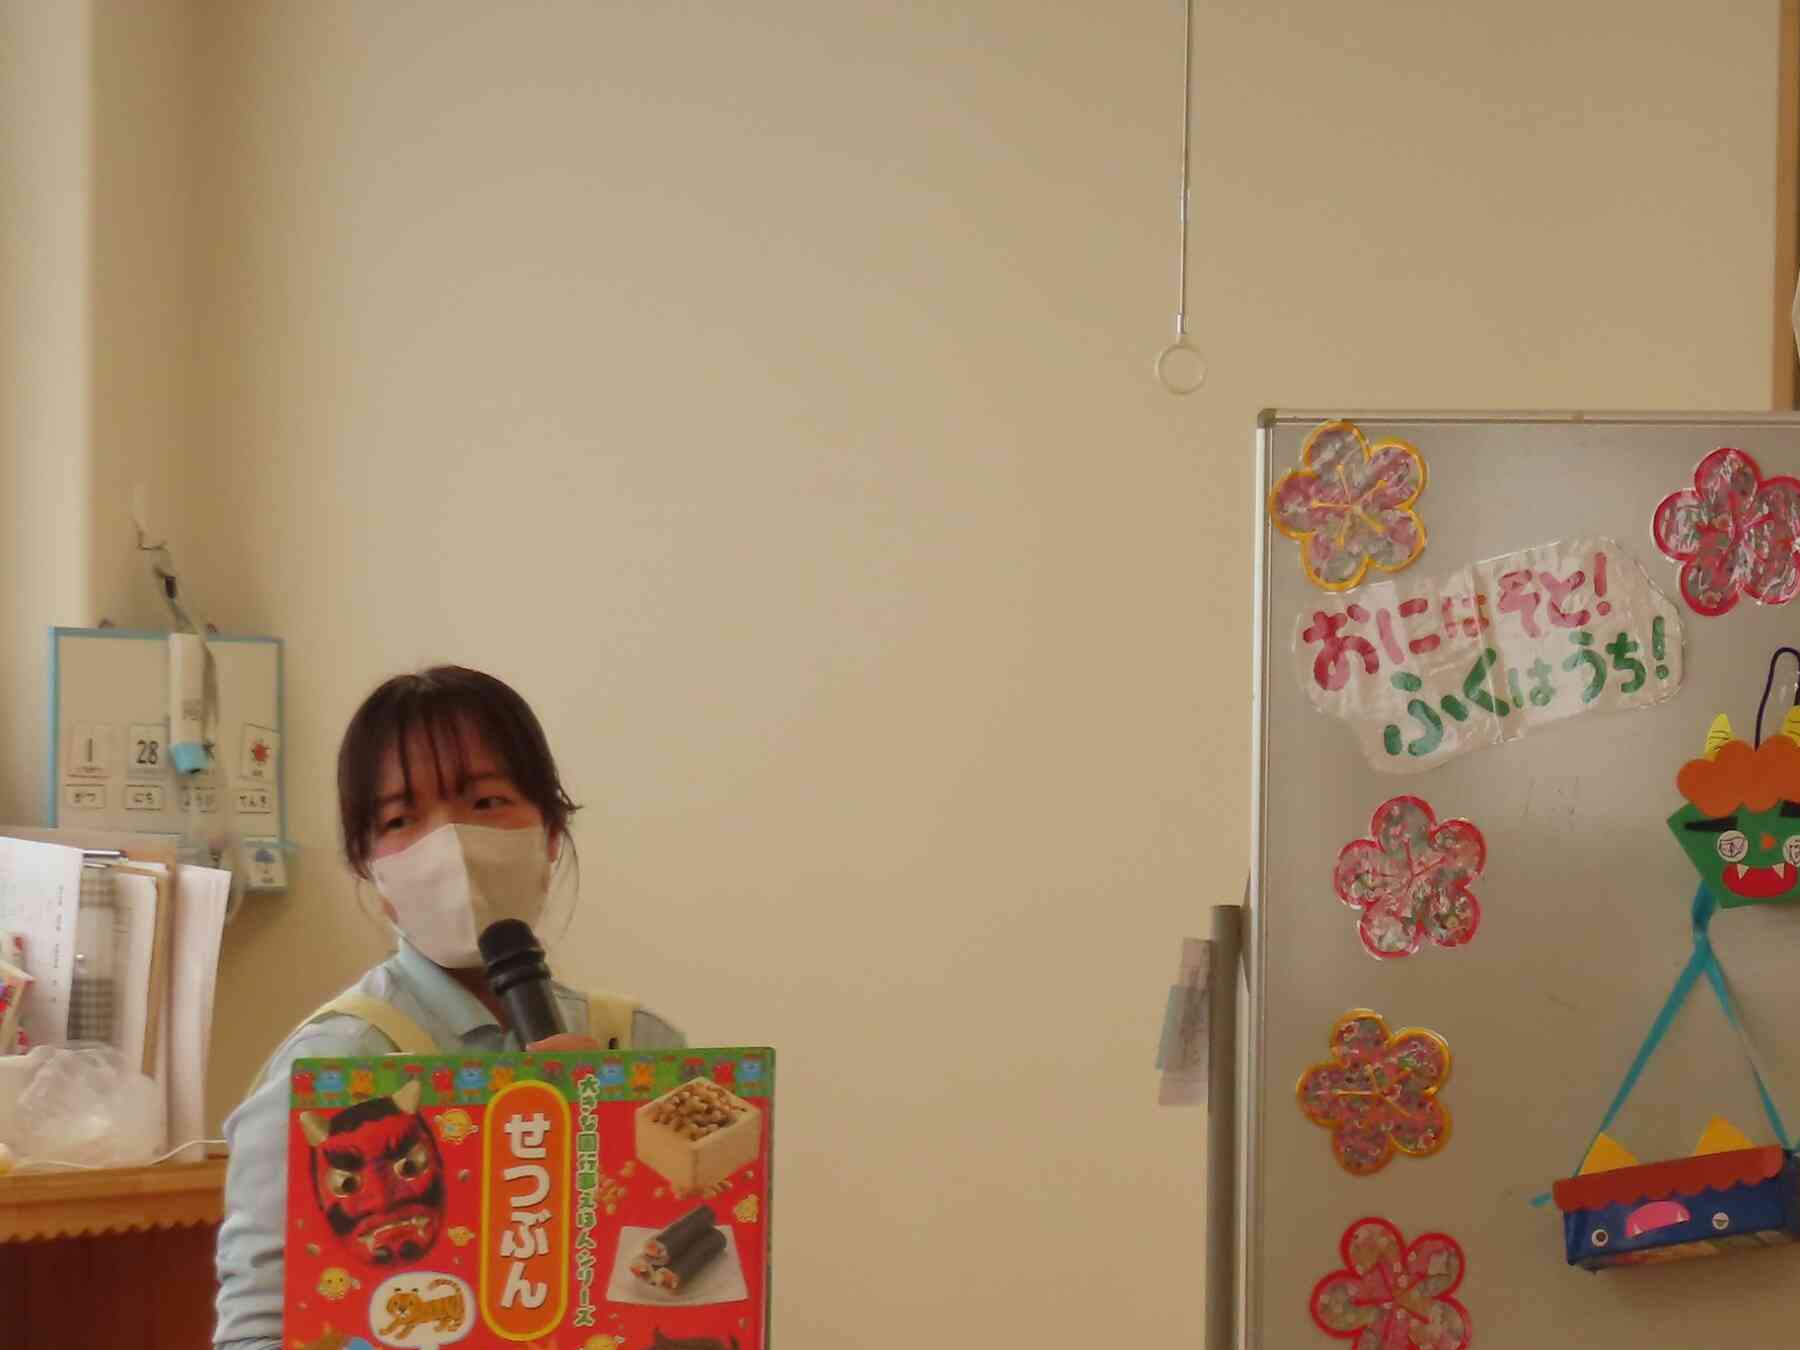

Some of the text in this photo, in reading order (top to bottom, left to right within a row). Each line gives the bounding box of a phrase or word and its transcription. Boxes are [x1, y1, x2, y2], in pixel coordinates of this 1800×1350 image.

[137, 739, 159, 765] 28
[500, 1113, 552, 1309] せつぶん
